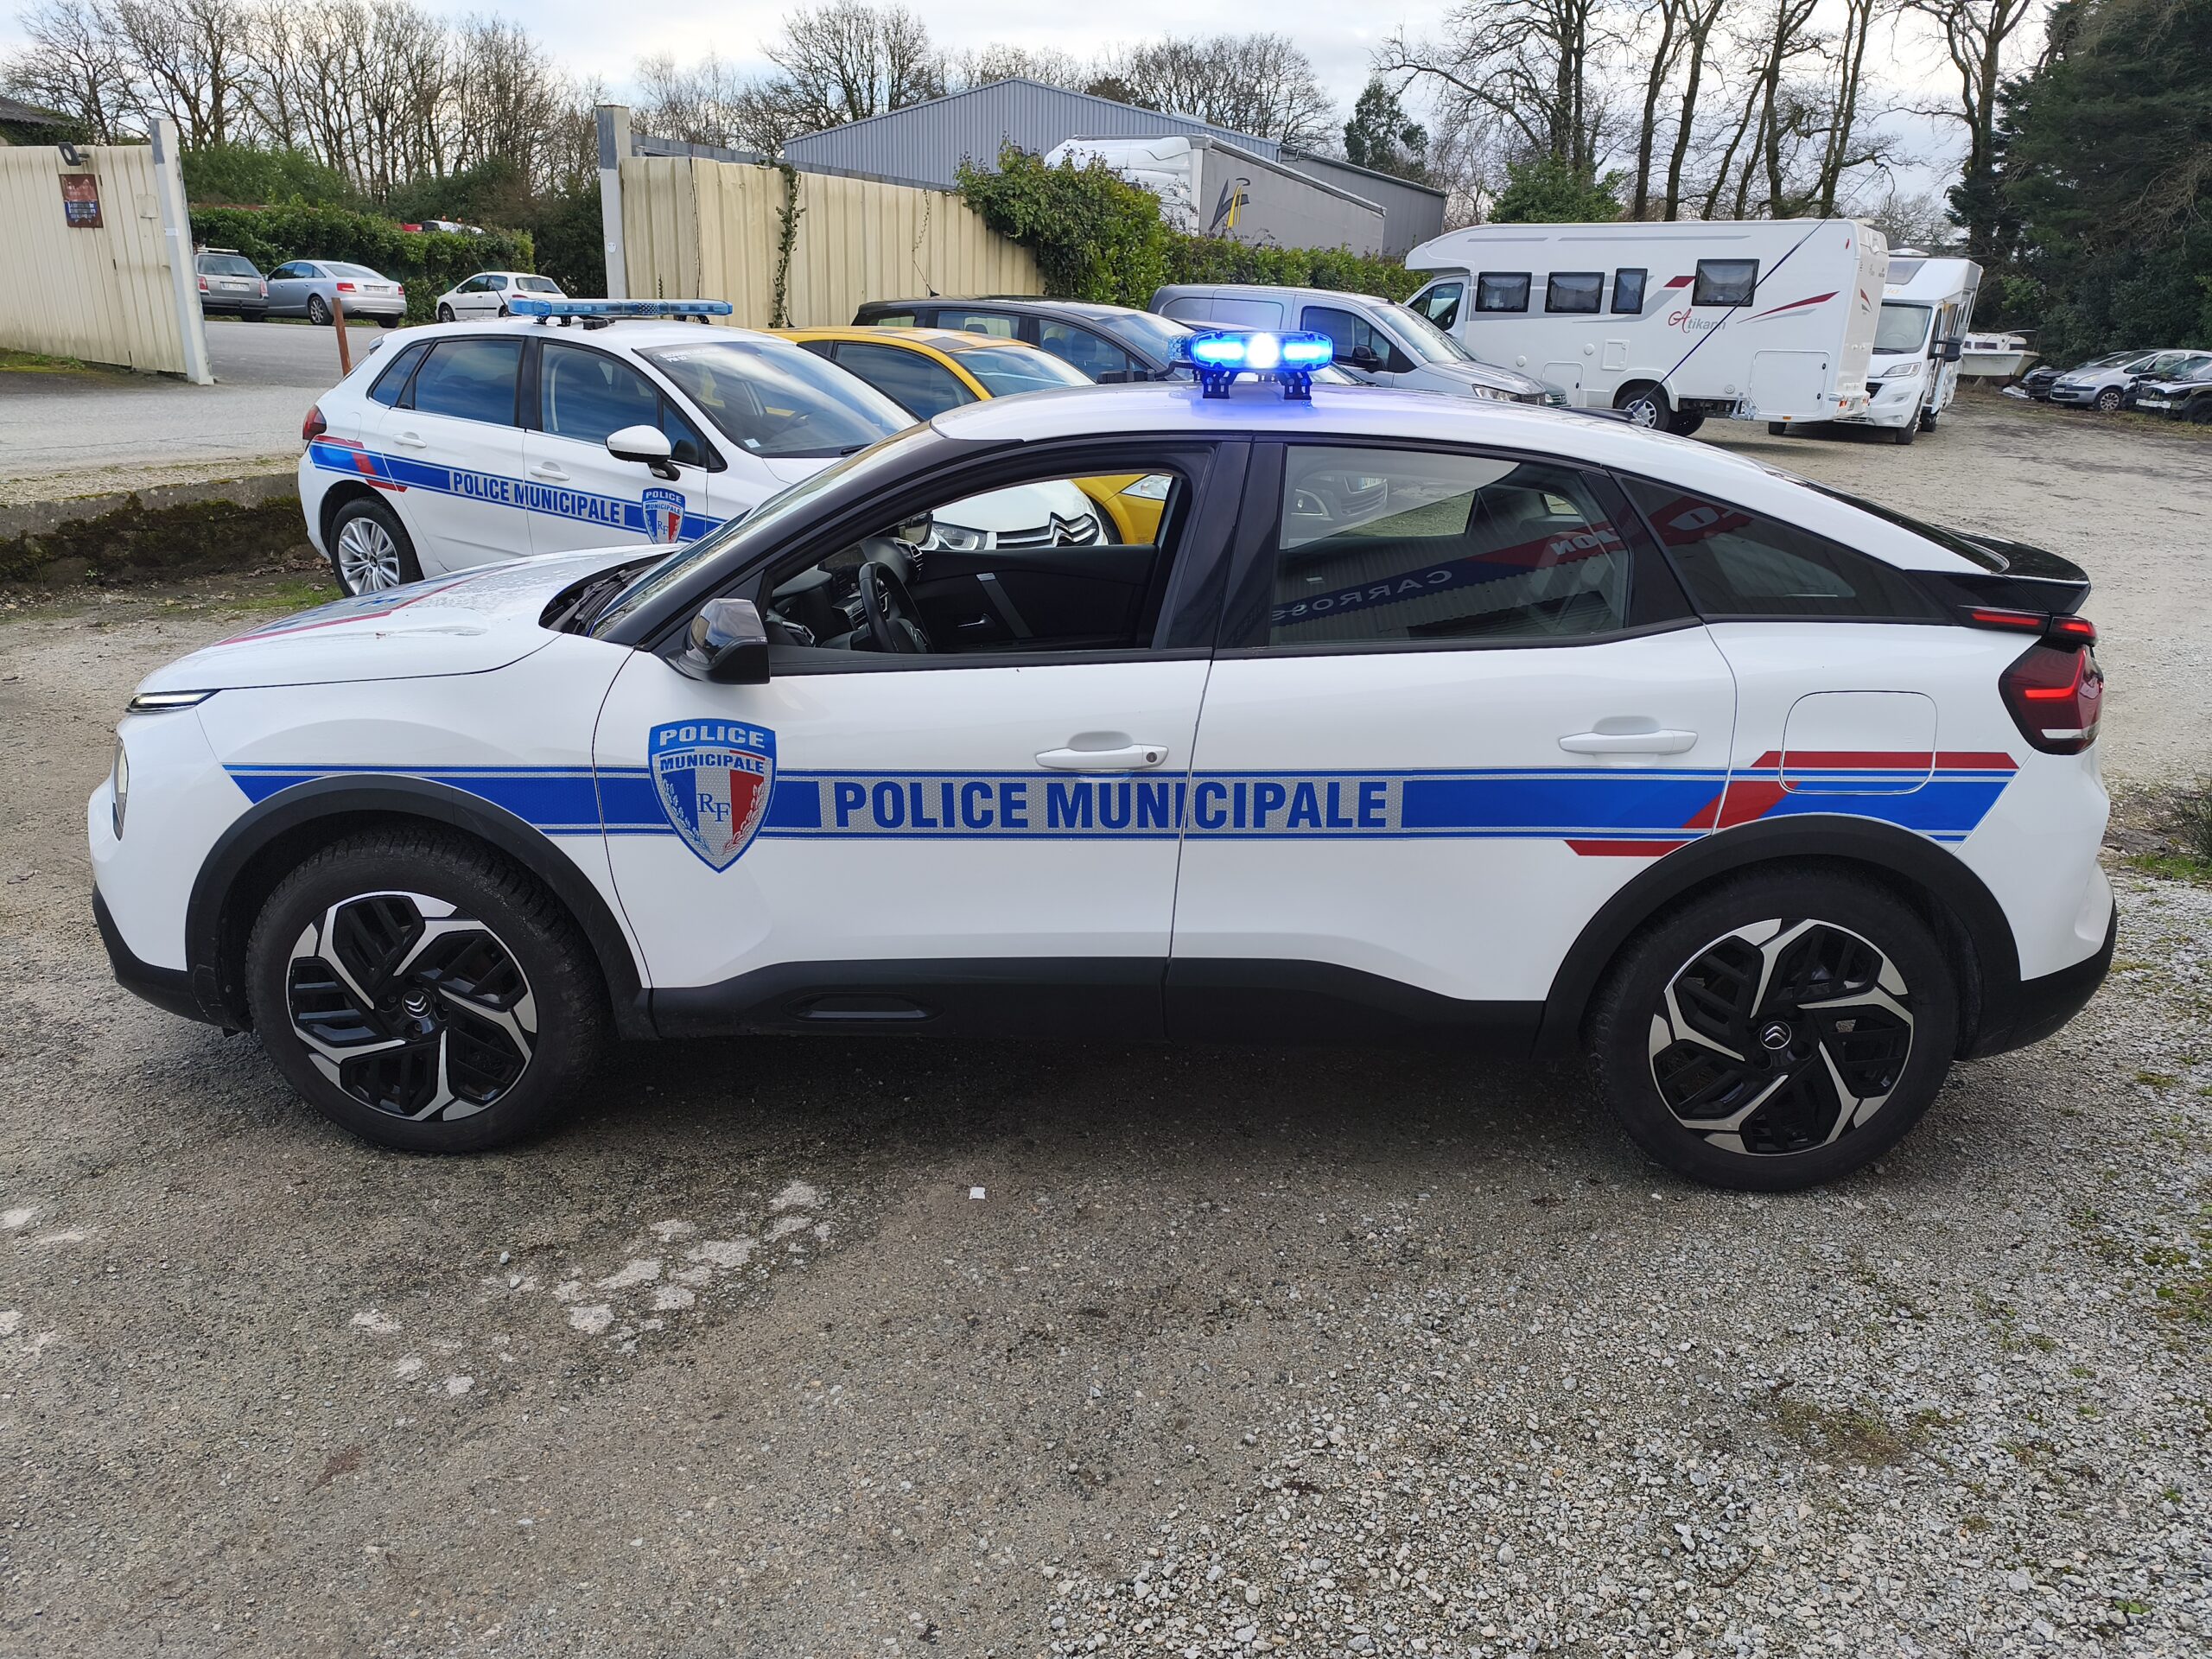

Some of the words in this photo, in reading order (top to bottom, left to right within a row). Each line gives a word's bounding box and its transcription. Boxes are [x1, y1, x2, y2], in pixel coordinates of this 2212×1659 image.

[454, 472, 509, 501] POLICE
[514, 483, 620, 524] MUNICIPALE
[645, 491, 682, 504] POLICE
[645, 504, 681, 514] MUNICIPALE
[658, 521, 669, 534] RF
[659, 725, 766, 749] POLICE
[660, 753, 765, 774] MUNICIPALE
[698, 792, 731, 823] RF
[835, 781, 1028, 829] POLICE
[1046, 781, 1387, 829] MUNICIPALE
